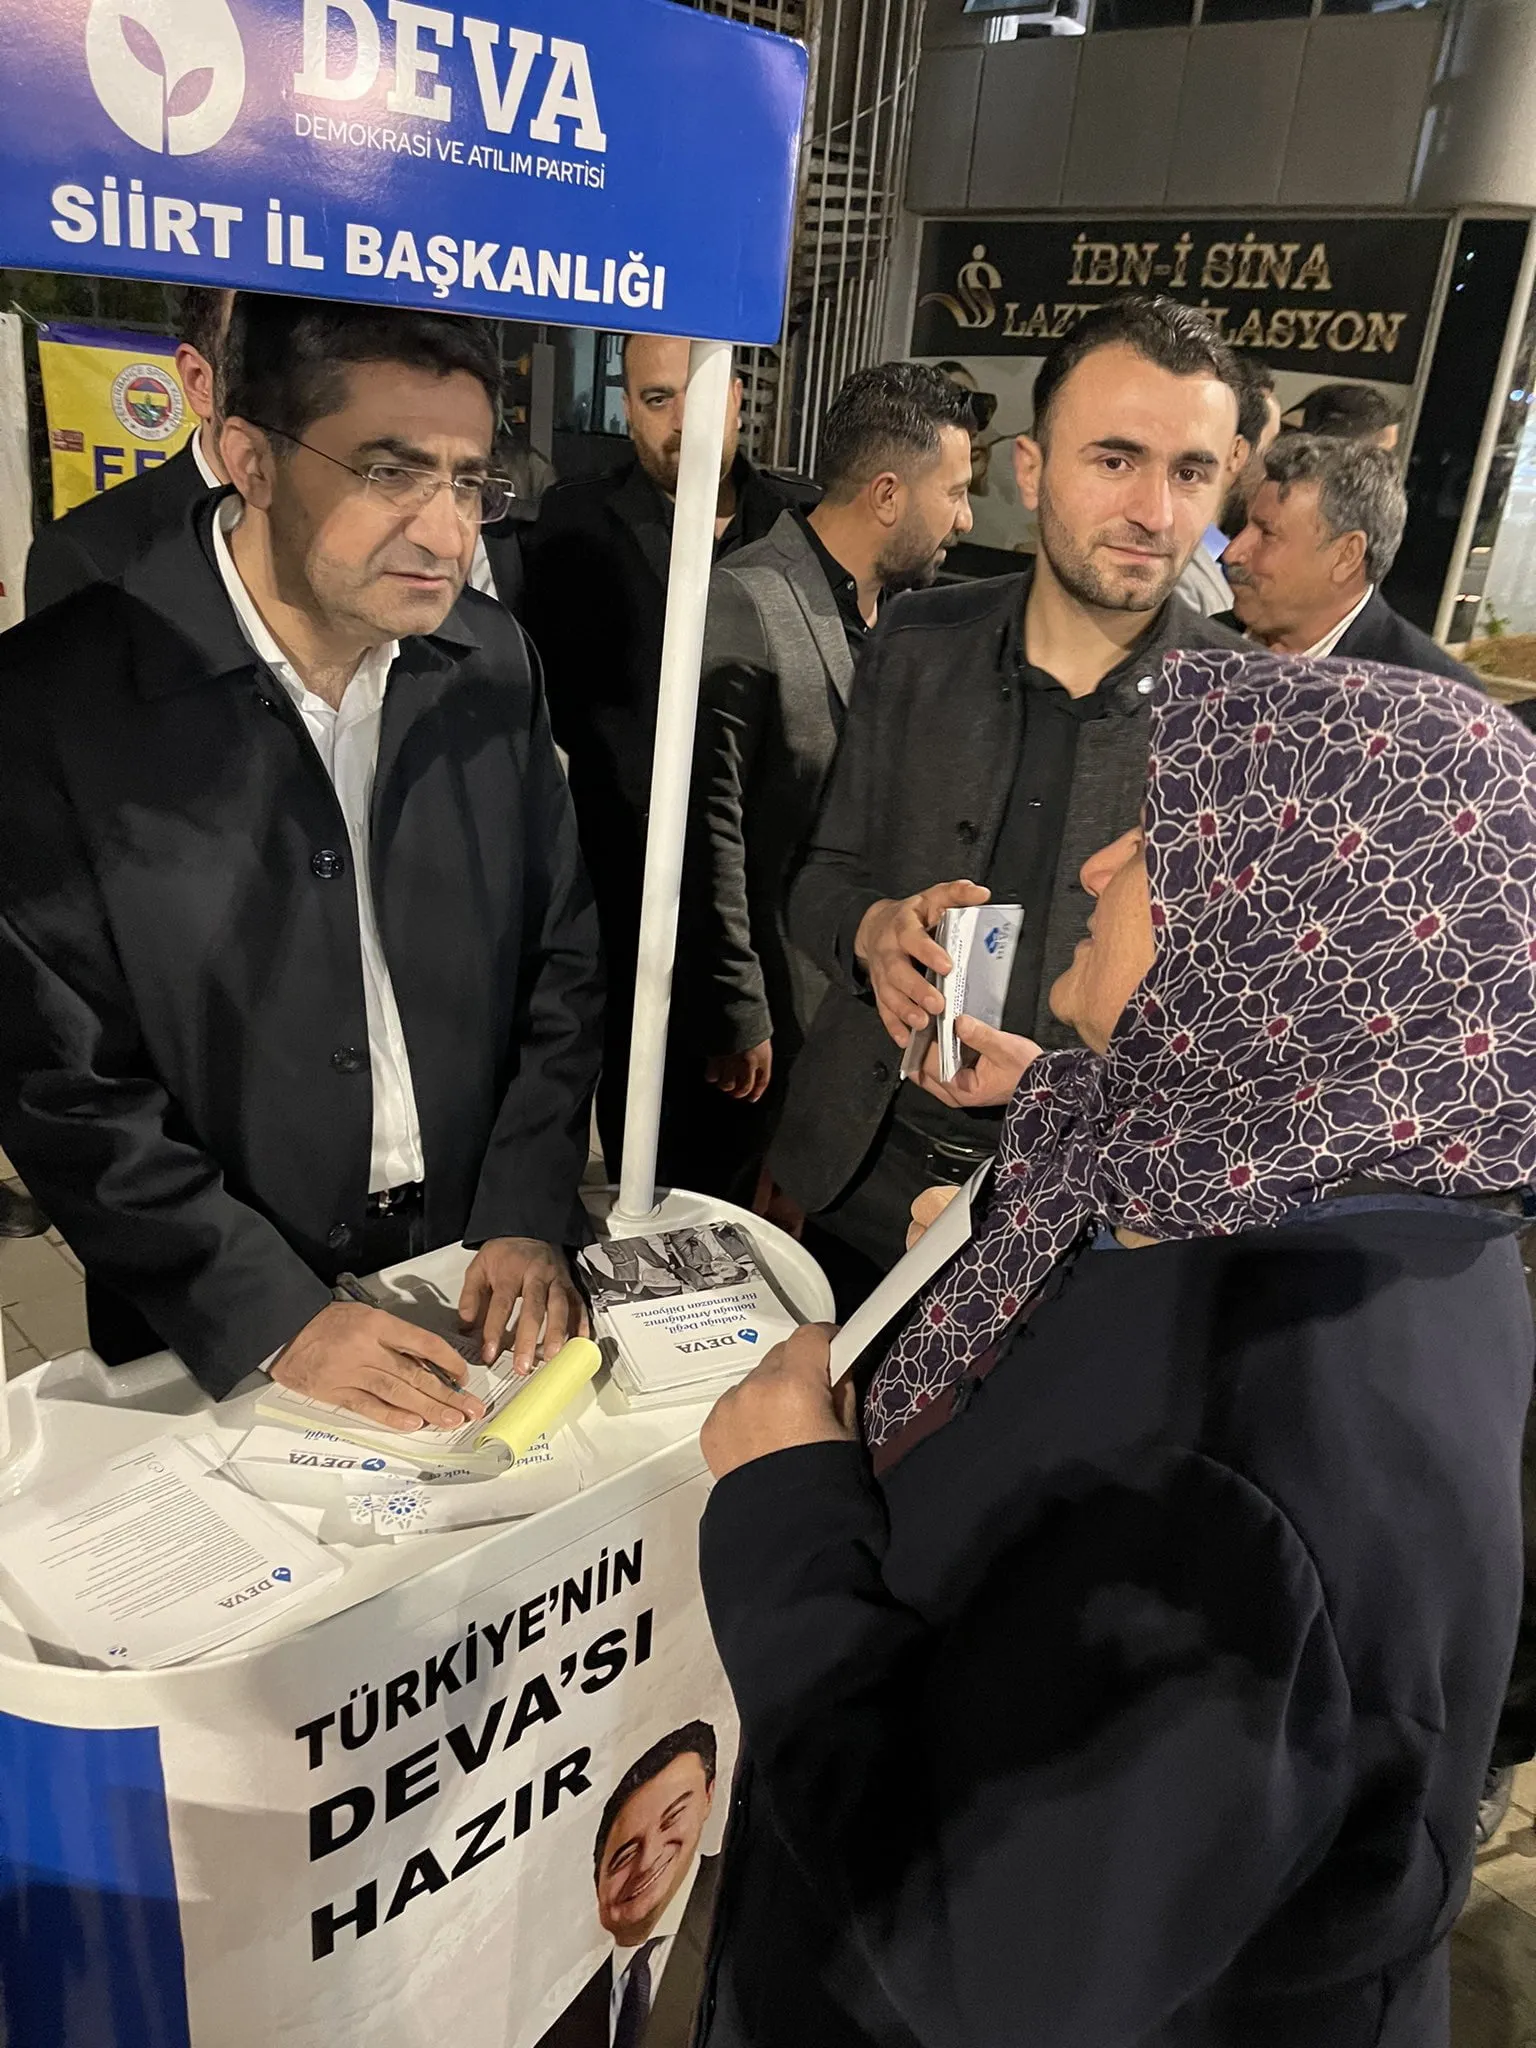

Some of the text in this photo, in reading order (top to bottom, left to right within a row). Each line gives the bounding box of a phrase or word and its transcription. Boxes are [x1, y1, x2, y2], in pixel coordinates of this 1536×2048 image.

[293, 0, 608, 153] DEVA
[294, 112, 606, 190] DEMOKRASİ VE ATILIM PARTİSİ
[51, 175, 667, 311] SİİRT İL BAŞKANLIĞI
[1067, 230, 1333, 291] İBN-İ SİNA
[632, 1292, 758, 1319] Bir Ramazan Diliyoruz.
[713, 1303, 756, 1315] Bolluğu
[664, 1314, 747, 1335] Yokluğu Değil,
[675, 1336, 737, 1353] DEVA
[289, 1453, 357, 1469] DEVA
[514, 1453, 554, 1468] Türki
[219, 1579, 274, 1608] DEVA
[311, 1746, 593, 1962] HAZIR
